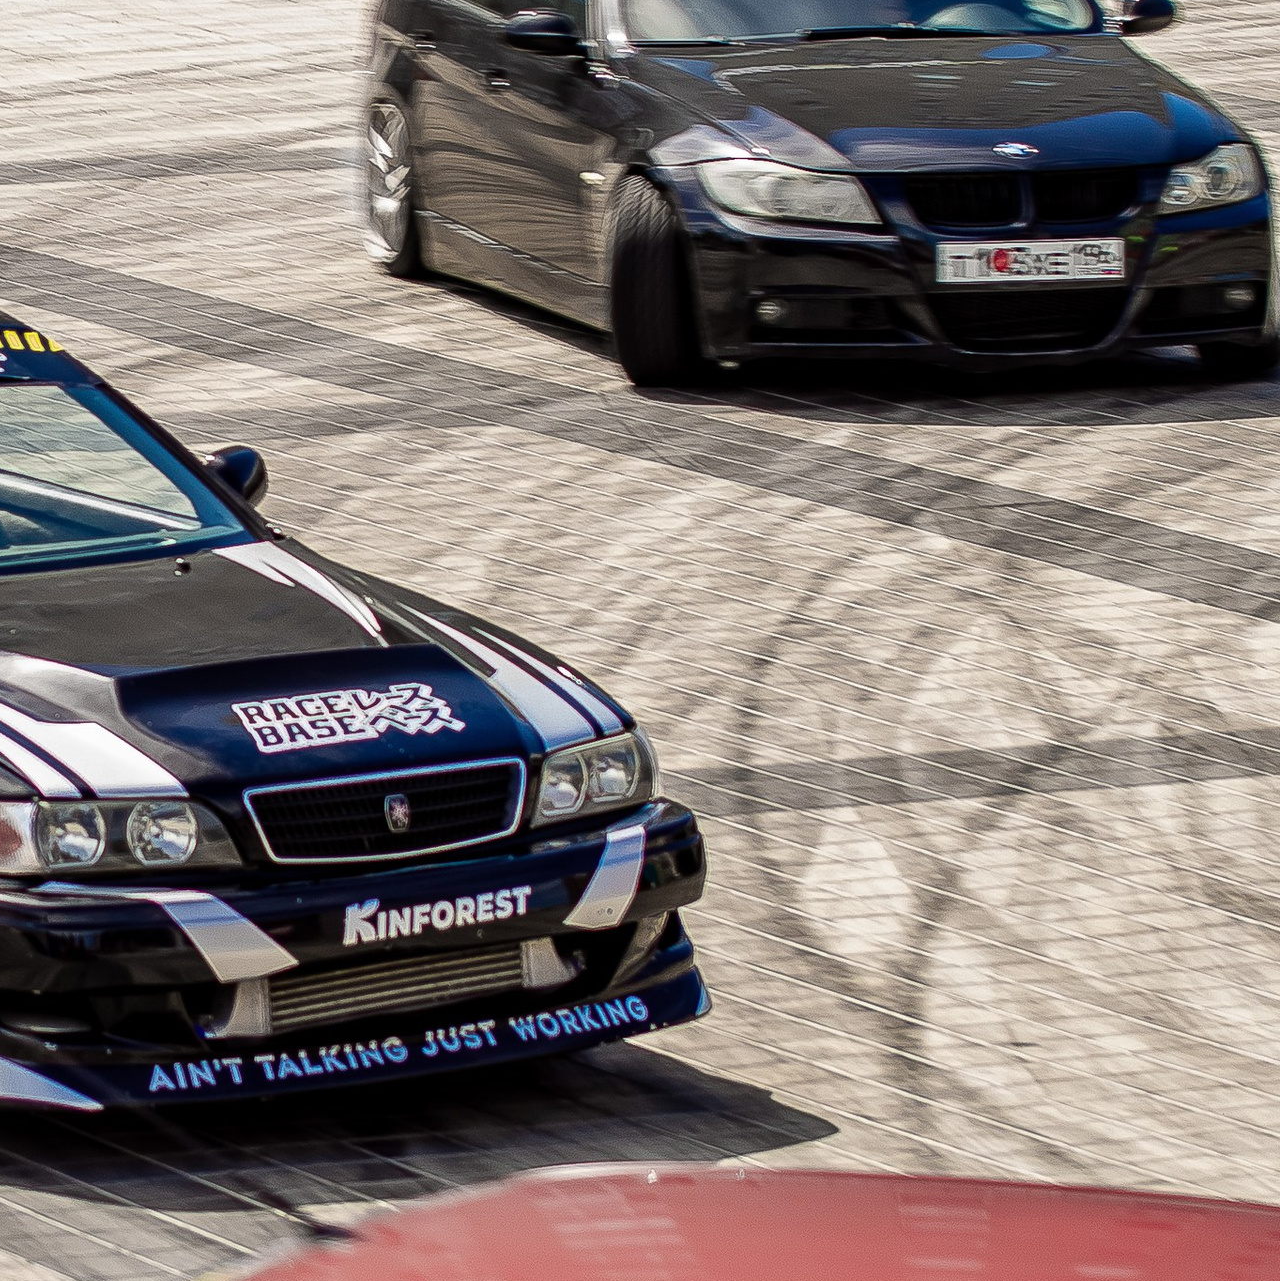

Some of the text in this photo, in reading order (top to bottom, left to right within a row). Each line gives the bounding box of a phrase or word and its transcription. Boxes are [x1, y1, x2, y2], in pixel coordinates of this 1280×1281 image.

[238, 694, 352, 725] RACE
[252, 716, 366, 747] BASE
[342, 884, 532, 947] KINFOREST
[148, 995, 650, 1093] AIN'T TALKING JUST WORKING
